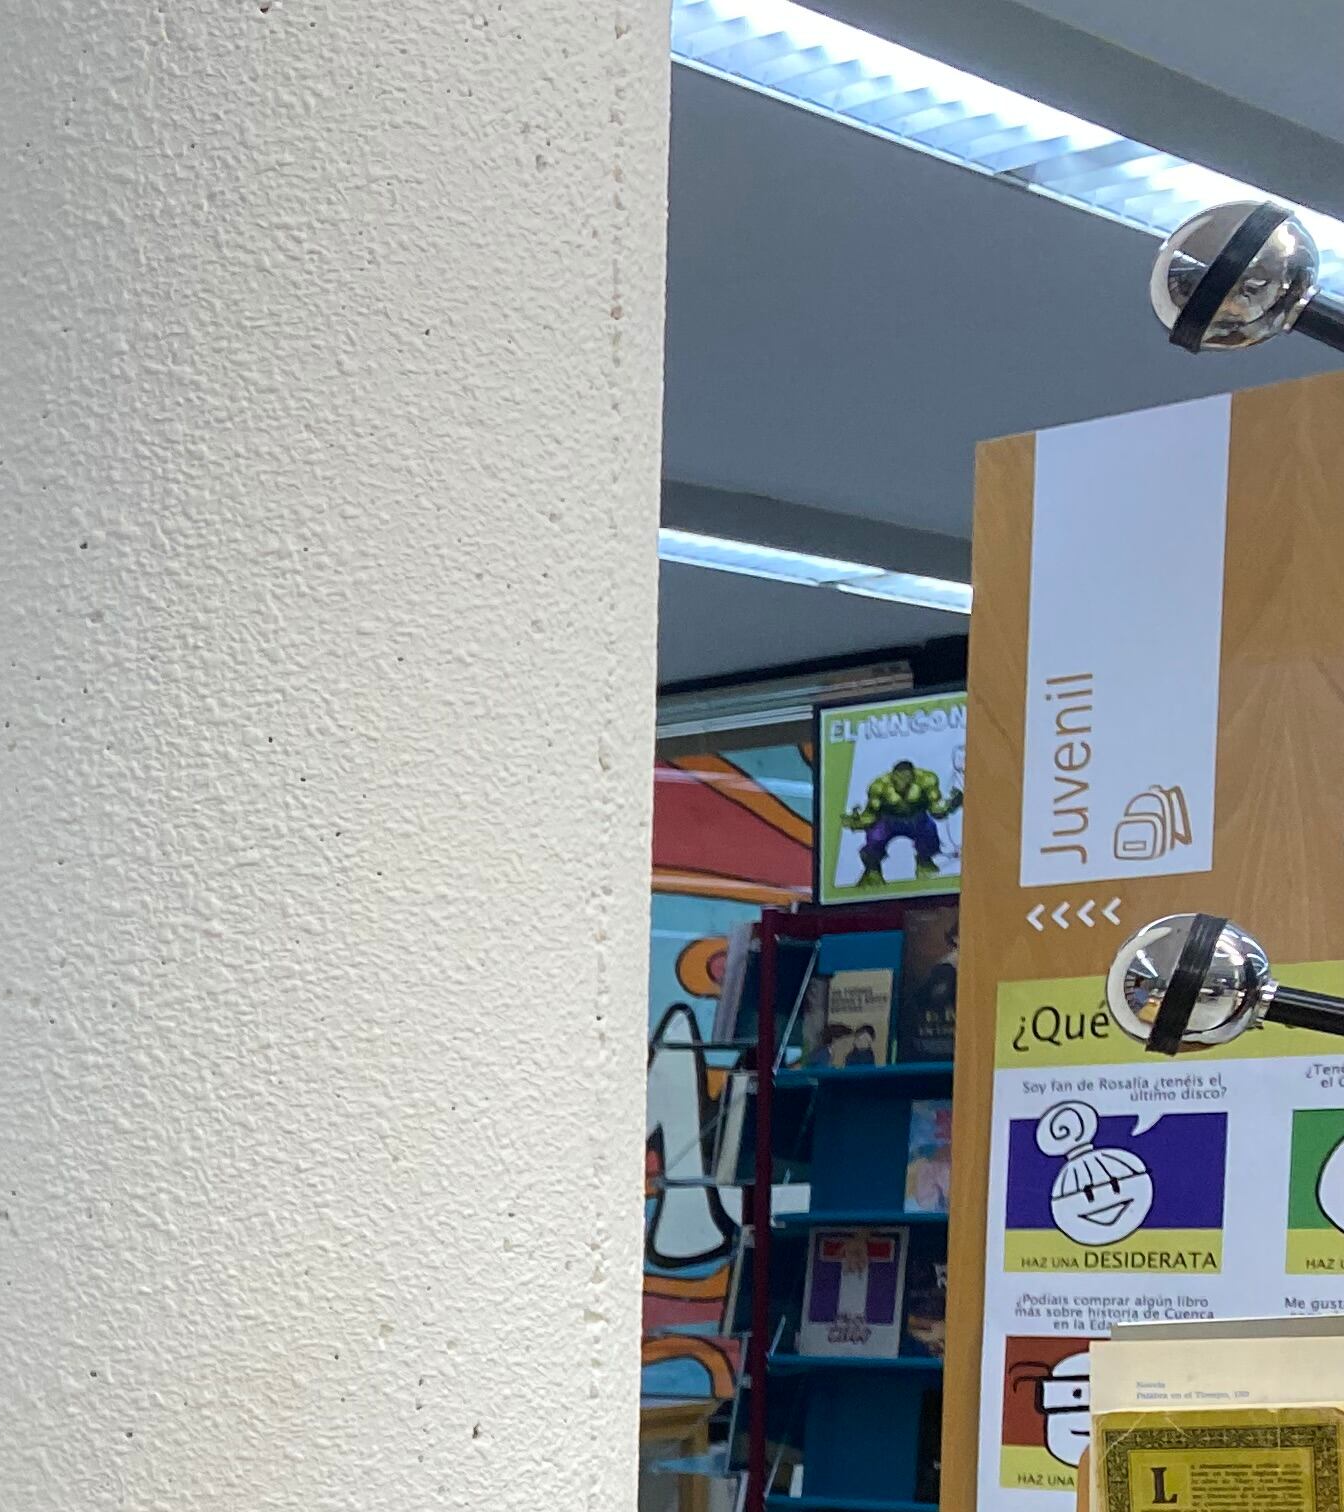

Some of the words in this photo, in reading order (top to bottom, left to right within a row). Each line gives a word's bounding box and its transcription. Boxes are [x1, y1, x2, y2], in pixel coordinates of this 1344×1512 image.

[1040, 673, 1093, 864] Juvenil
[1012, 1002, 1112, 1052] ¿Qué
[1022, 1080, 1046, 1096] Soy
[1050, 1079, 1073, 1093] fan
[1077, 1077, 1095, 1091] de
[1099, 1075, 1149, 1091] Rosalía
[1153, 1074, 1204, 1093] ¿tenéis
[1209, 1072, 1222, 1087] el
[1130, 1086, 1177, 1102] último
[1181, 1085, 1228, 1101] disco?
[1021, 1256, 1048, 1269] HAZ
[1051, 1256, 1079, 1268] UNA
[1084, 1250, 1218, 1270] DESIDERATA
[1306, 1257, 1335, 1271] HAZ
[1073, 1296, 1131, 1310] comprar
[1135, 1294, 1173, 1310] algún
[1177, 1294, 1209, 1308] libro
[1285, 1297, 1306, 1309] Me
[1015, 1305, 1043, 1319] más
[1046, 1306, 1084, 1319] sobre
[1087, 1306, 1140, 1320] historia
[1143, 1306, 1161, 1319] de
[1053, 1320, 1070, 1331] en
[1073, 1318, 1086, 1330] la
[1017, 1474, 1045, 1486] HAZ
[1047, 1474, 1075, 1486] UNA
